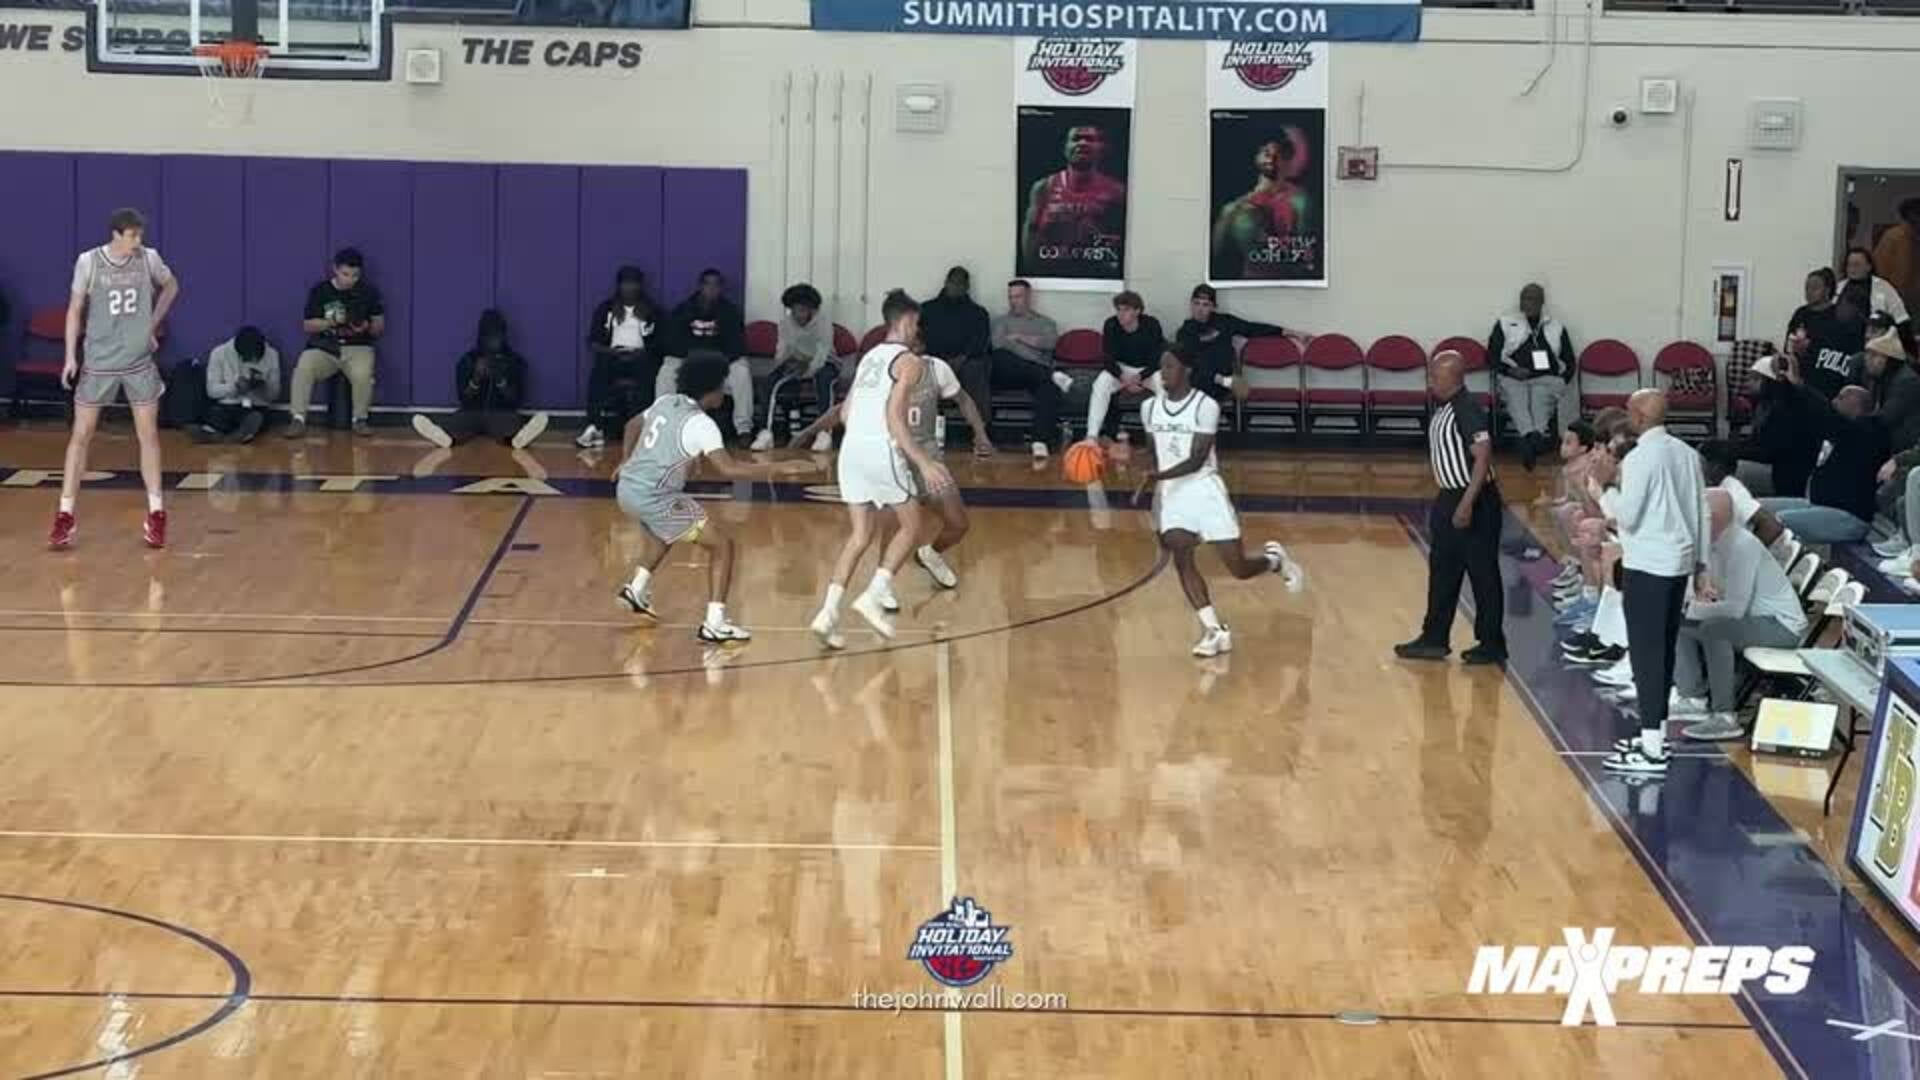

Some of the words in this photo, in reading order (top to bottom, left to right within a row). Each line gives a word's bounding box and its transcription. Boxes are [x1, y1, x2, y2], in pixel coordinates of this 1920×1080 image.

[903, 1, 1328, 33] SUMMITHOSPITALITY.COM
[0, 24, 52, 50] WE
[462, 38, 534, 65] THE
[544, 40, 643, 68] CAPS
[1038, 42, 1116, 57] HOLIDAY
[1232, 40, 1305, 55] HOLIDAY
[1030, 57, 1121, 69] INVITATIONAL
[1225, 54, 1311, 66] INVITATIONAL
[108, 287, 138, 316] 22
[644, 415, 667, 449] 5
